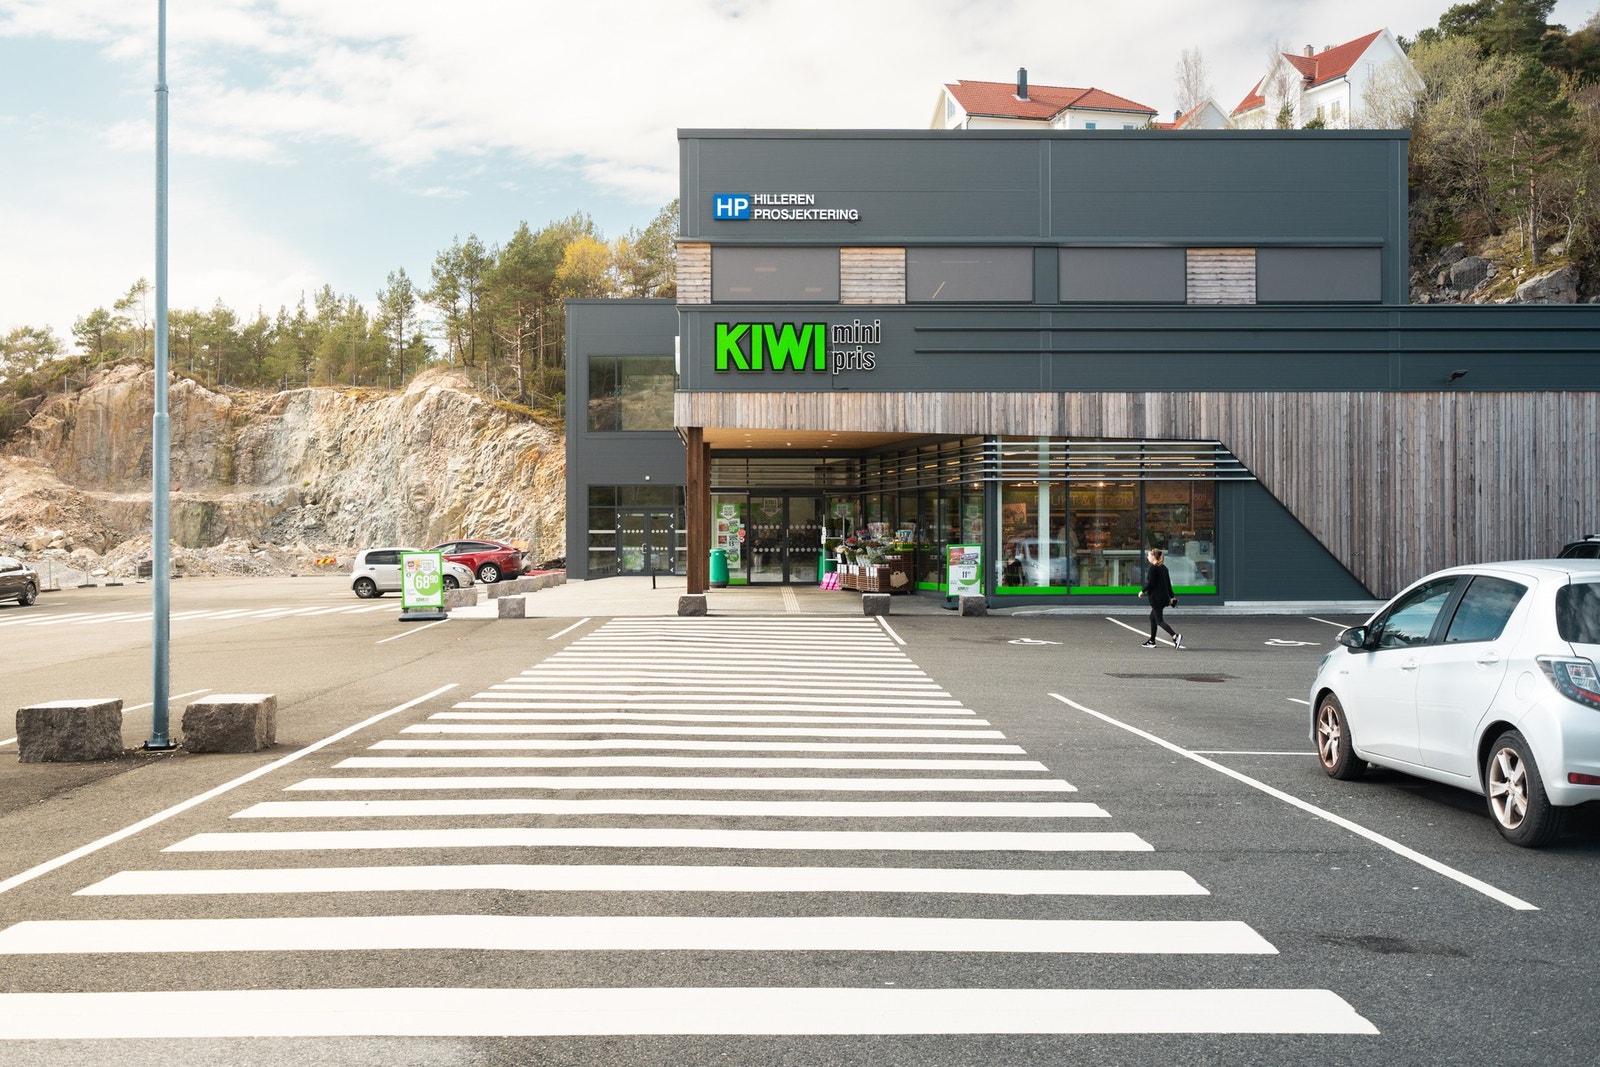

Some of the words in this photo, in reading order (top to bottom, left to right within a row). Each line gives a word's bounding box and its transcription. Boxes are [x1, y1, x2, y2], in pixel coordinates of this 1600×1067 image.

[717, 198, 749, 217] HP
[754, 194, 815, 205] HILLEREN
[754, 209, 858, 220] PROSJEKTERING
[833, 319, 881, 344] mini
[715, 322, 827, 371] KIWI
[832, 346, 876, 375] pris
